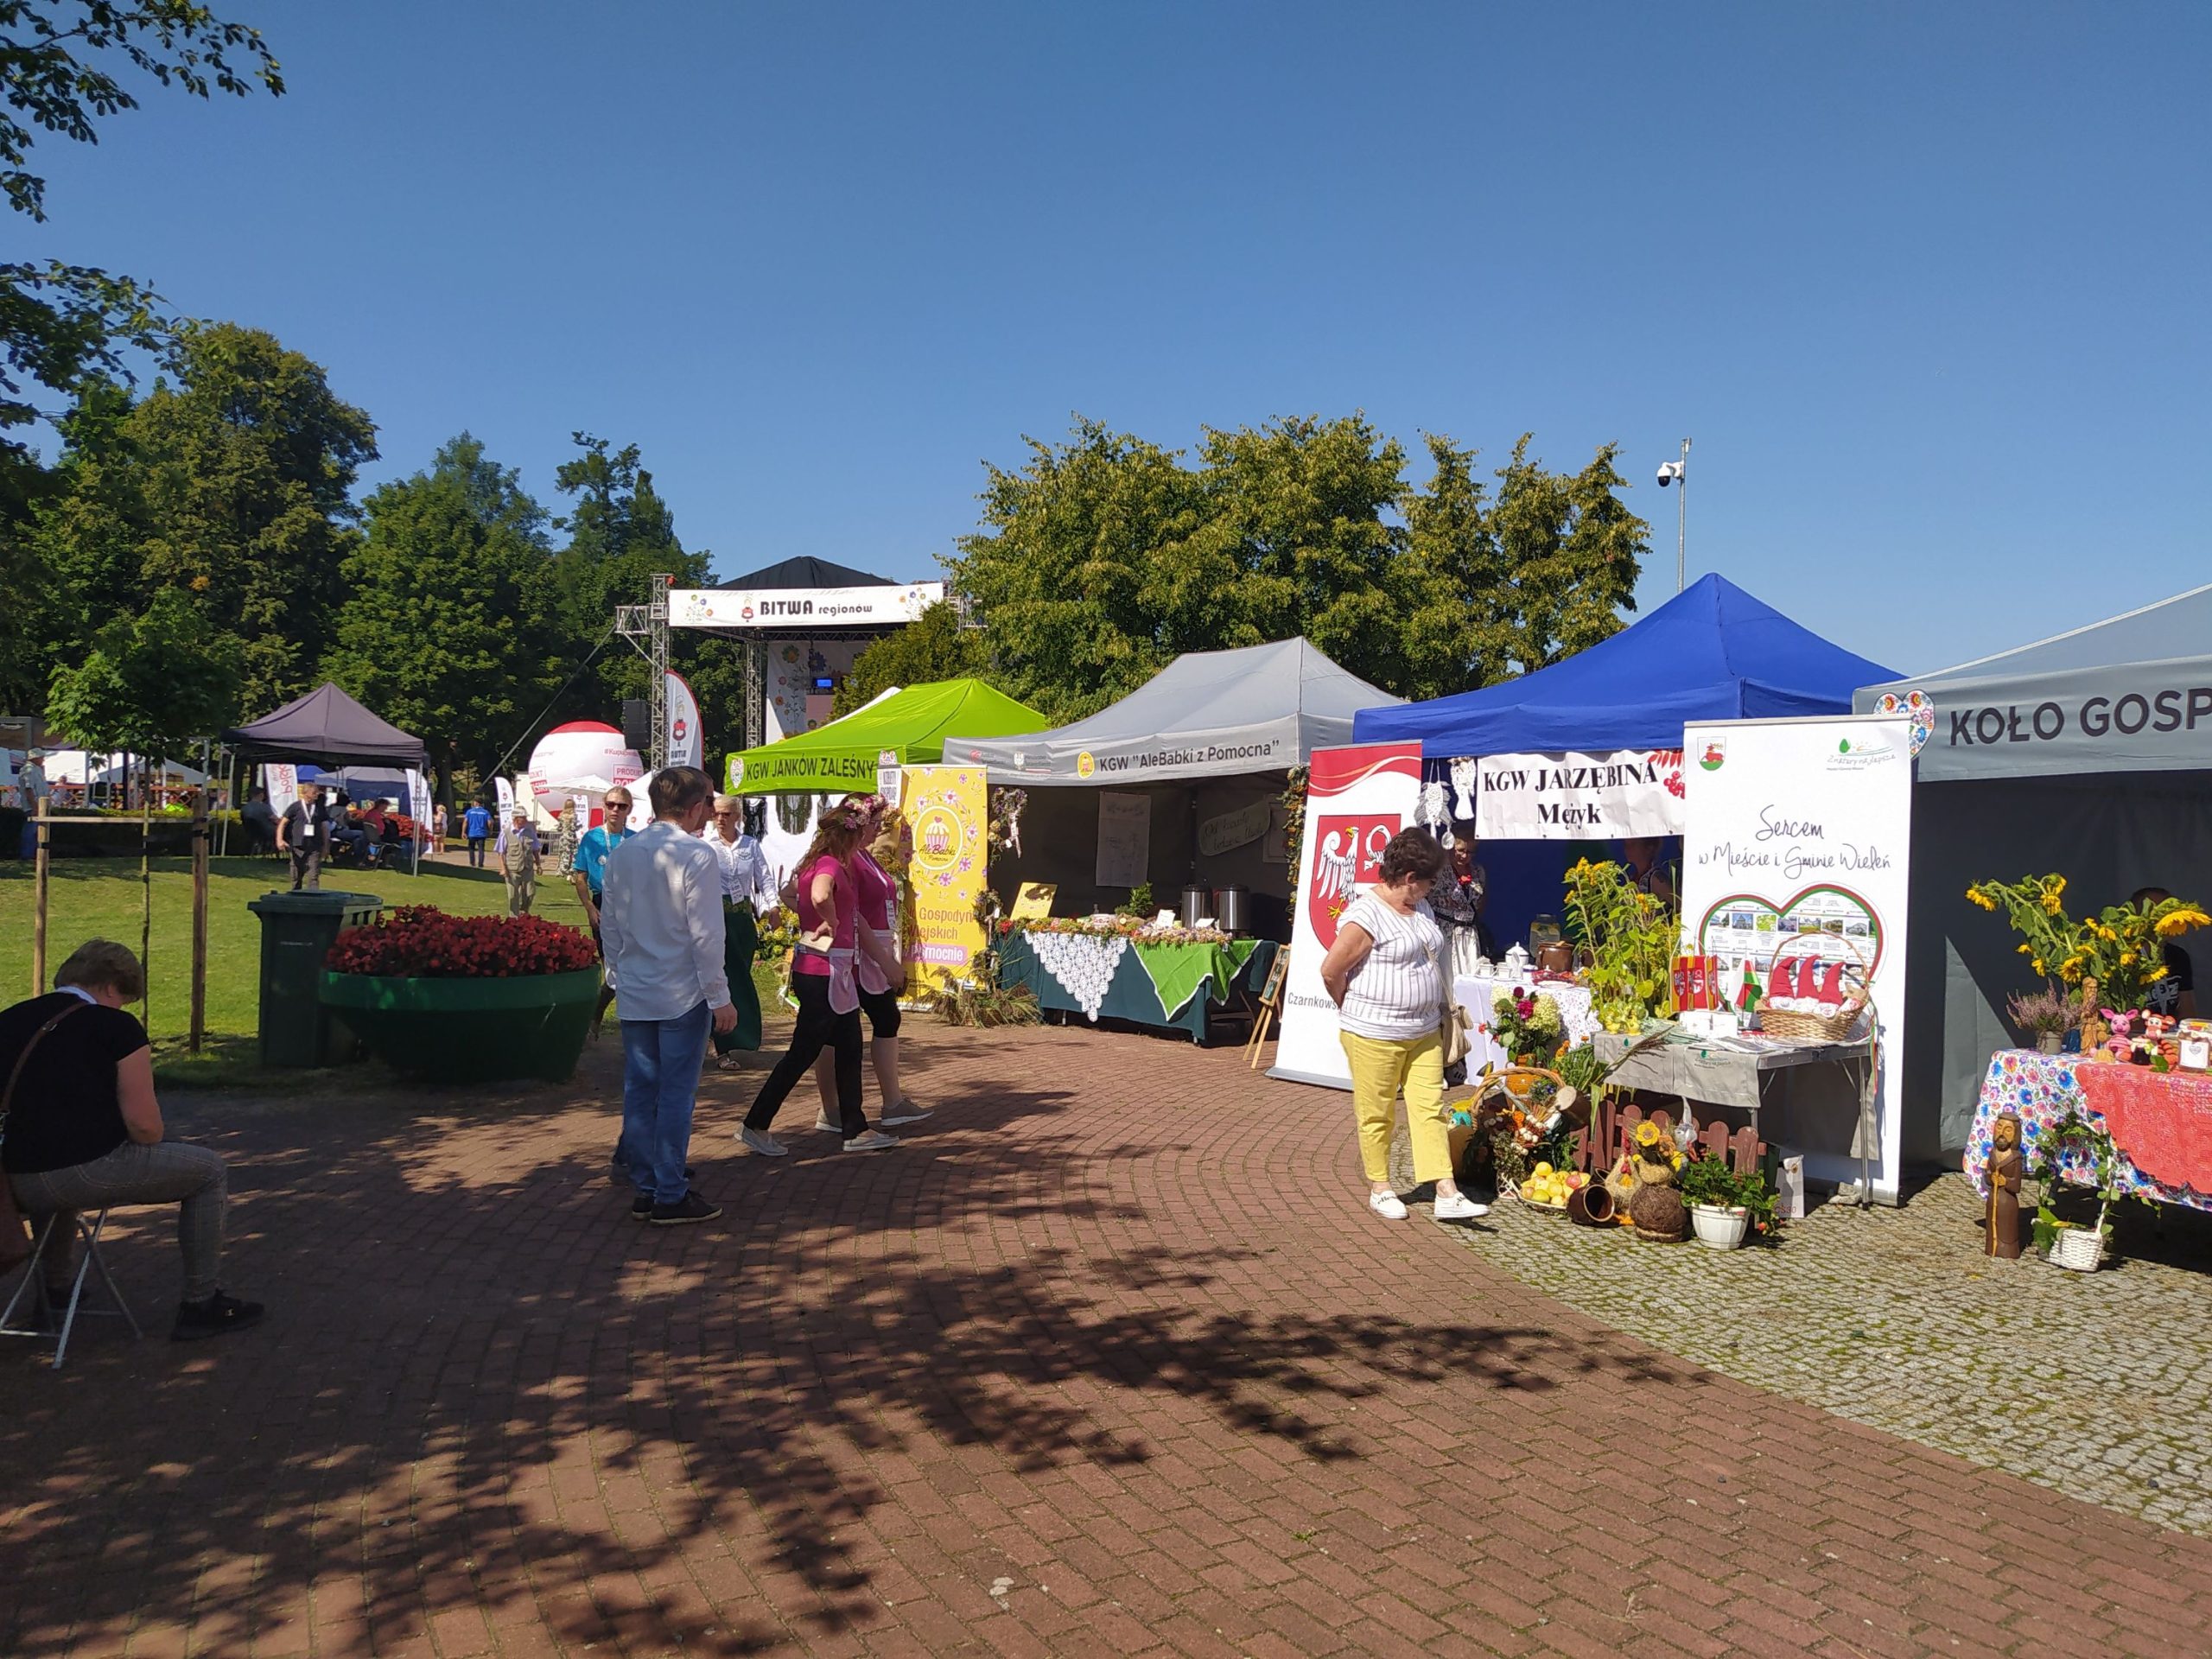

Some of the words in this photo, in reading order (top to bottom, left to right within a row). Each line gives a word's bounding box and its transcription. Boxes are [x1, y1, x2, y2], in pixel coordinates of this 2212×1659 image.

[760, 600, 813, 615] BITWA
[818, 603, 873, 617] regionów
[1950, 702, 2065, 746] KOŁO
[2080, 688, 2212, 737] GOSP
[747, 761, 769, 781] KGW
[772, 753, 817, 778] JANKÓW
[821, 753, 874, 779] ZALEŚNY
[1100, 757, 1128, 772] KGW
[1197, 751, 1204, 762] z
[1484, 770, 1530, 792] KGW
[1535, 762, 1658, 794] JARZĘBINA
[1536, 803, 1603, 830] Mężyk
[1755, 804, 1825, 841] Sercem
[1699, 853, 1708, 865] w
[1713, 842, 1770, 876] Mieście
[1774, 853, 1780, 866] i
[1783, 846, 1835, 880] Gminie
[1840, 843, 1891, 870] Wieleń
